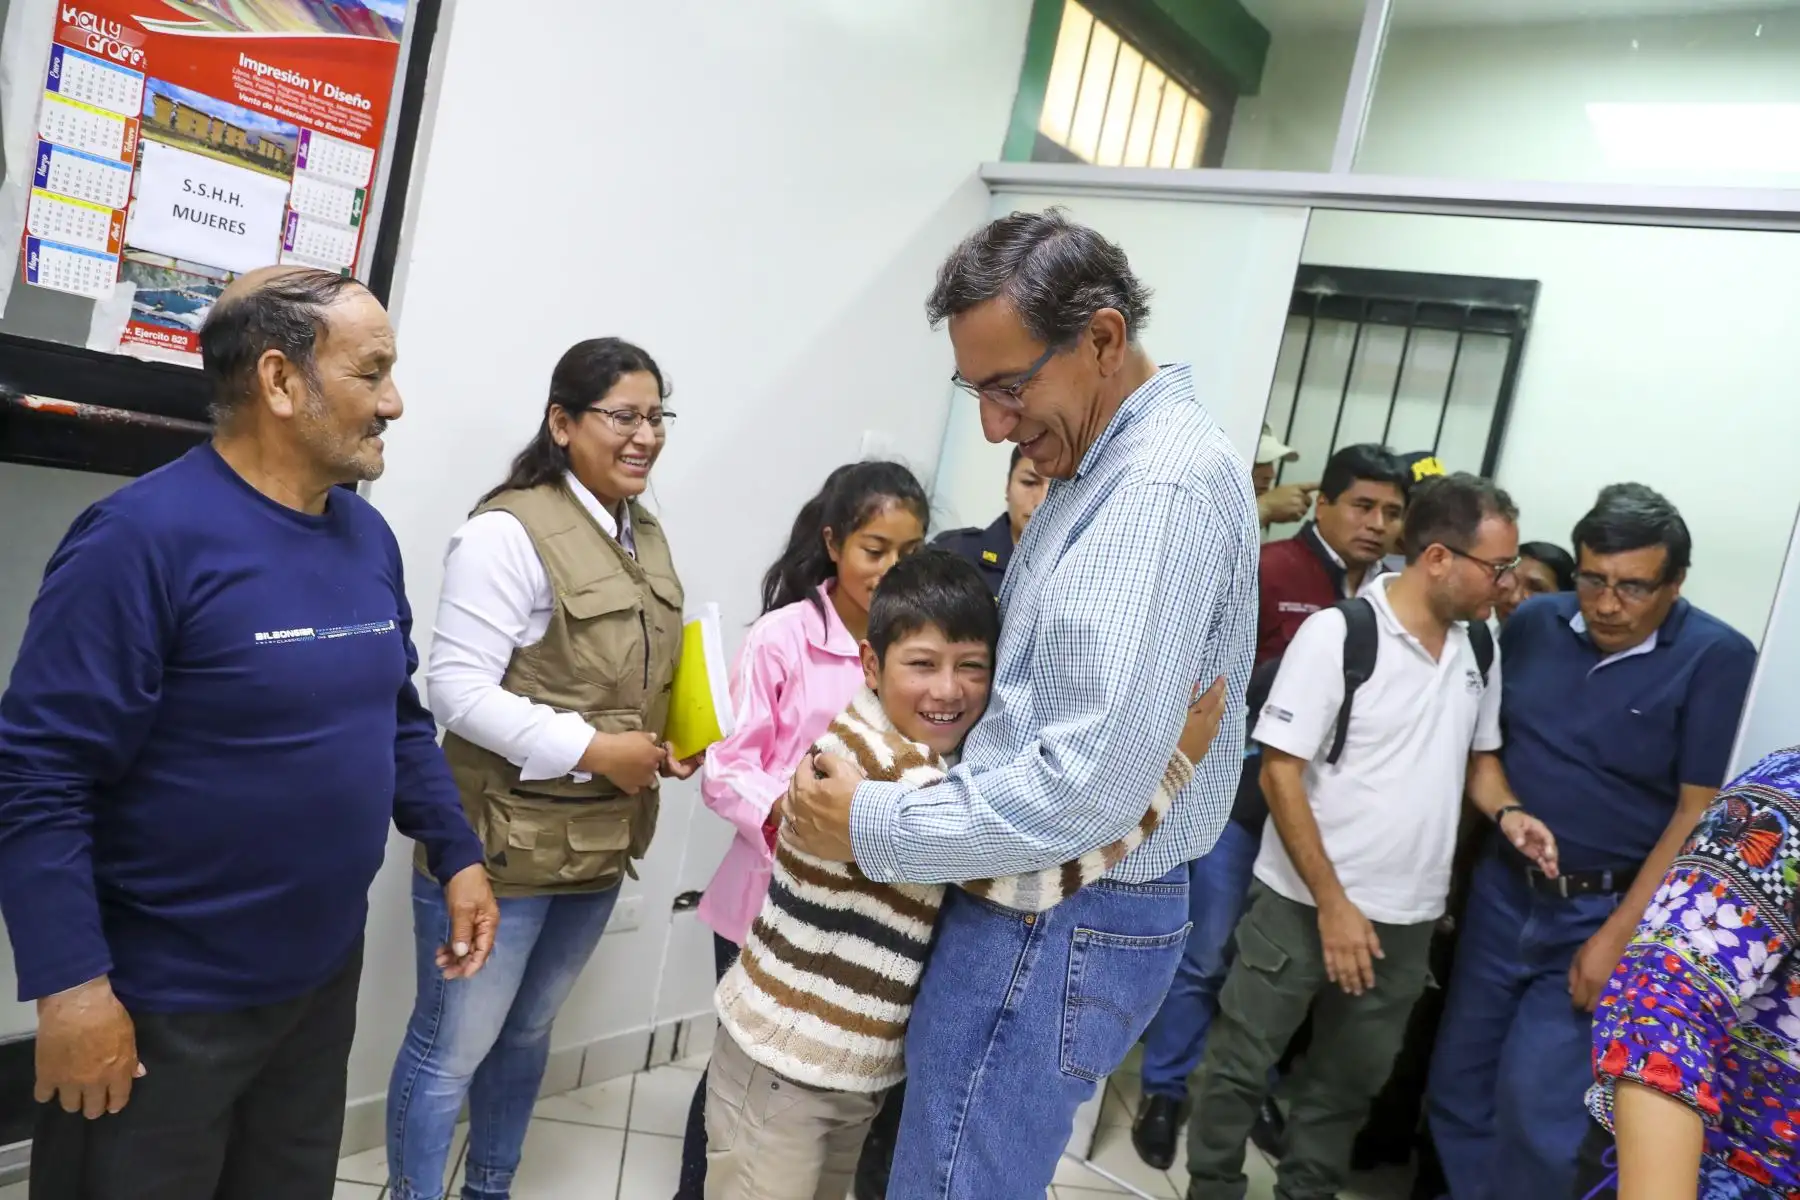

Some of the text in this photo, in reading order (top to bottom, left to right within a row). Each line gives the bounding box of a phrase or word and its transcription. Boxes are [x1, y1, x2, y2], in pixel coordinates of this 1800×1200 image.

[239, 52, 309, 90] Impresión
[312, 78, 322, 93] Y
[324, 83, 371, 110] Diseño
[182, 178, 243, 208] S.S.H.H.
[172, 204, 246, 235] MUJERES
[134, 327, 169, 342] Ejercito
